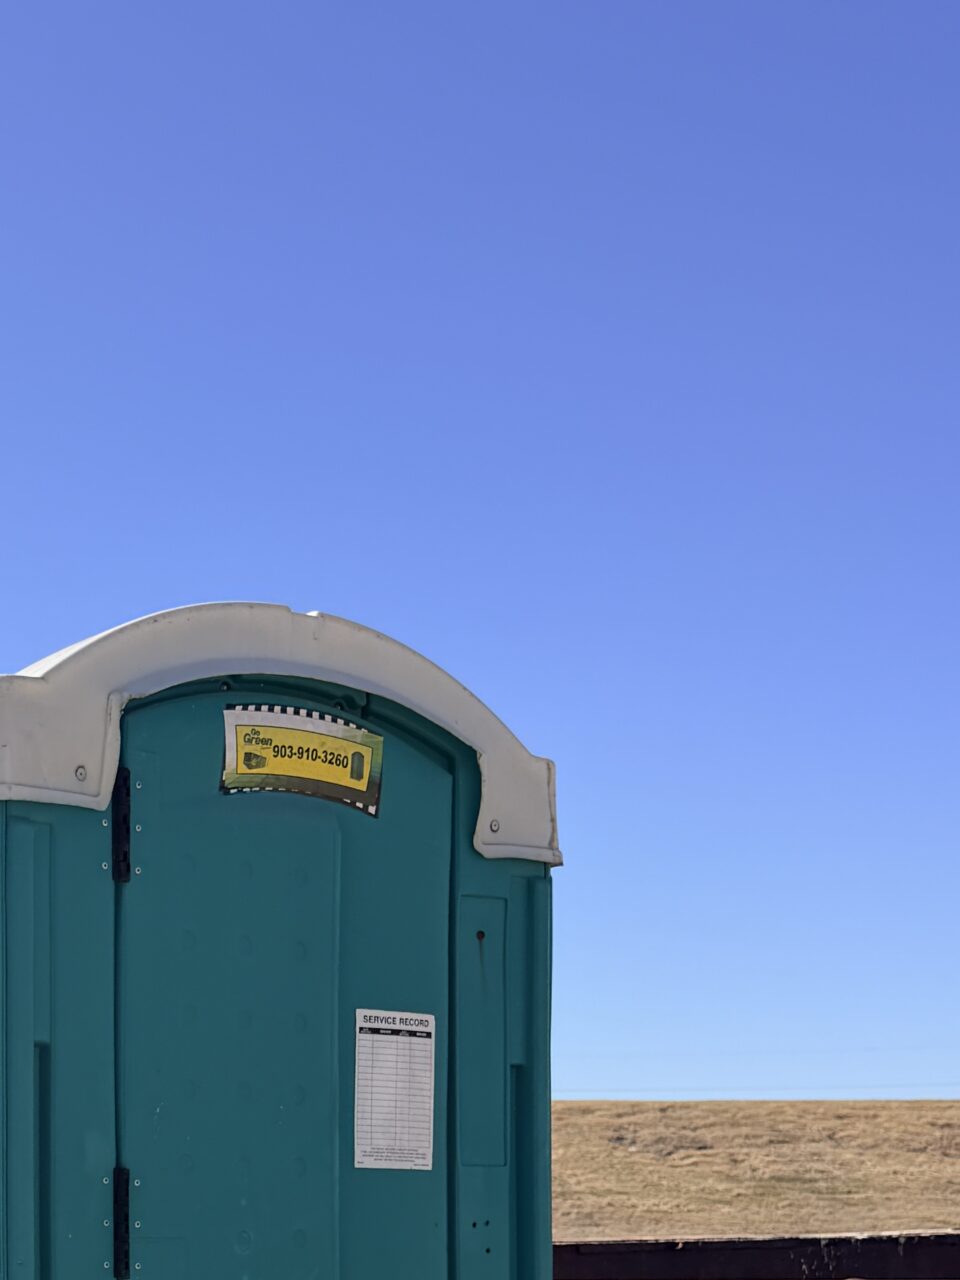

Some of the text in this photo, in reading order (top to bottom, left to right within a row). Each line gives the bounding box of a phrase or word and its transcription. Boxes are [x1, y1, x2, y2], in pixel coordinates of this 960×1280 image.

[251, 728, 261, 736] Go
[243, 733, 273, 746] Green
[272, 745, 349, 768] 903-910-3260
[363, 1015, 430, 1028] SERVICE RECORD
